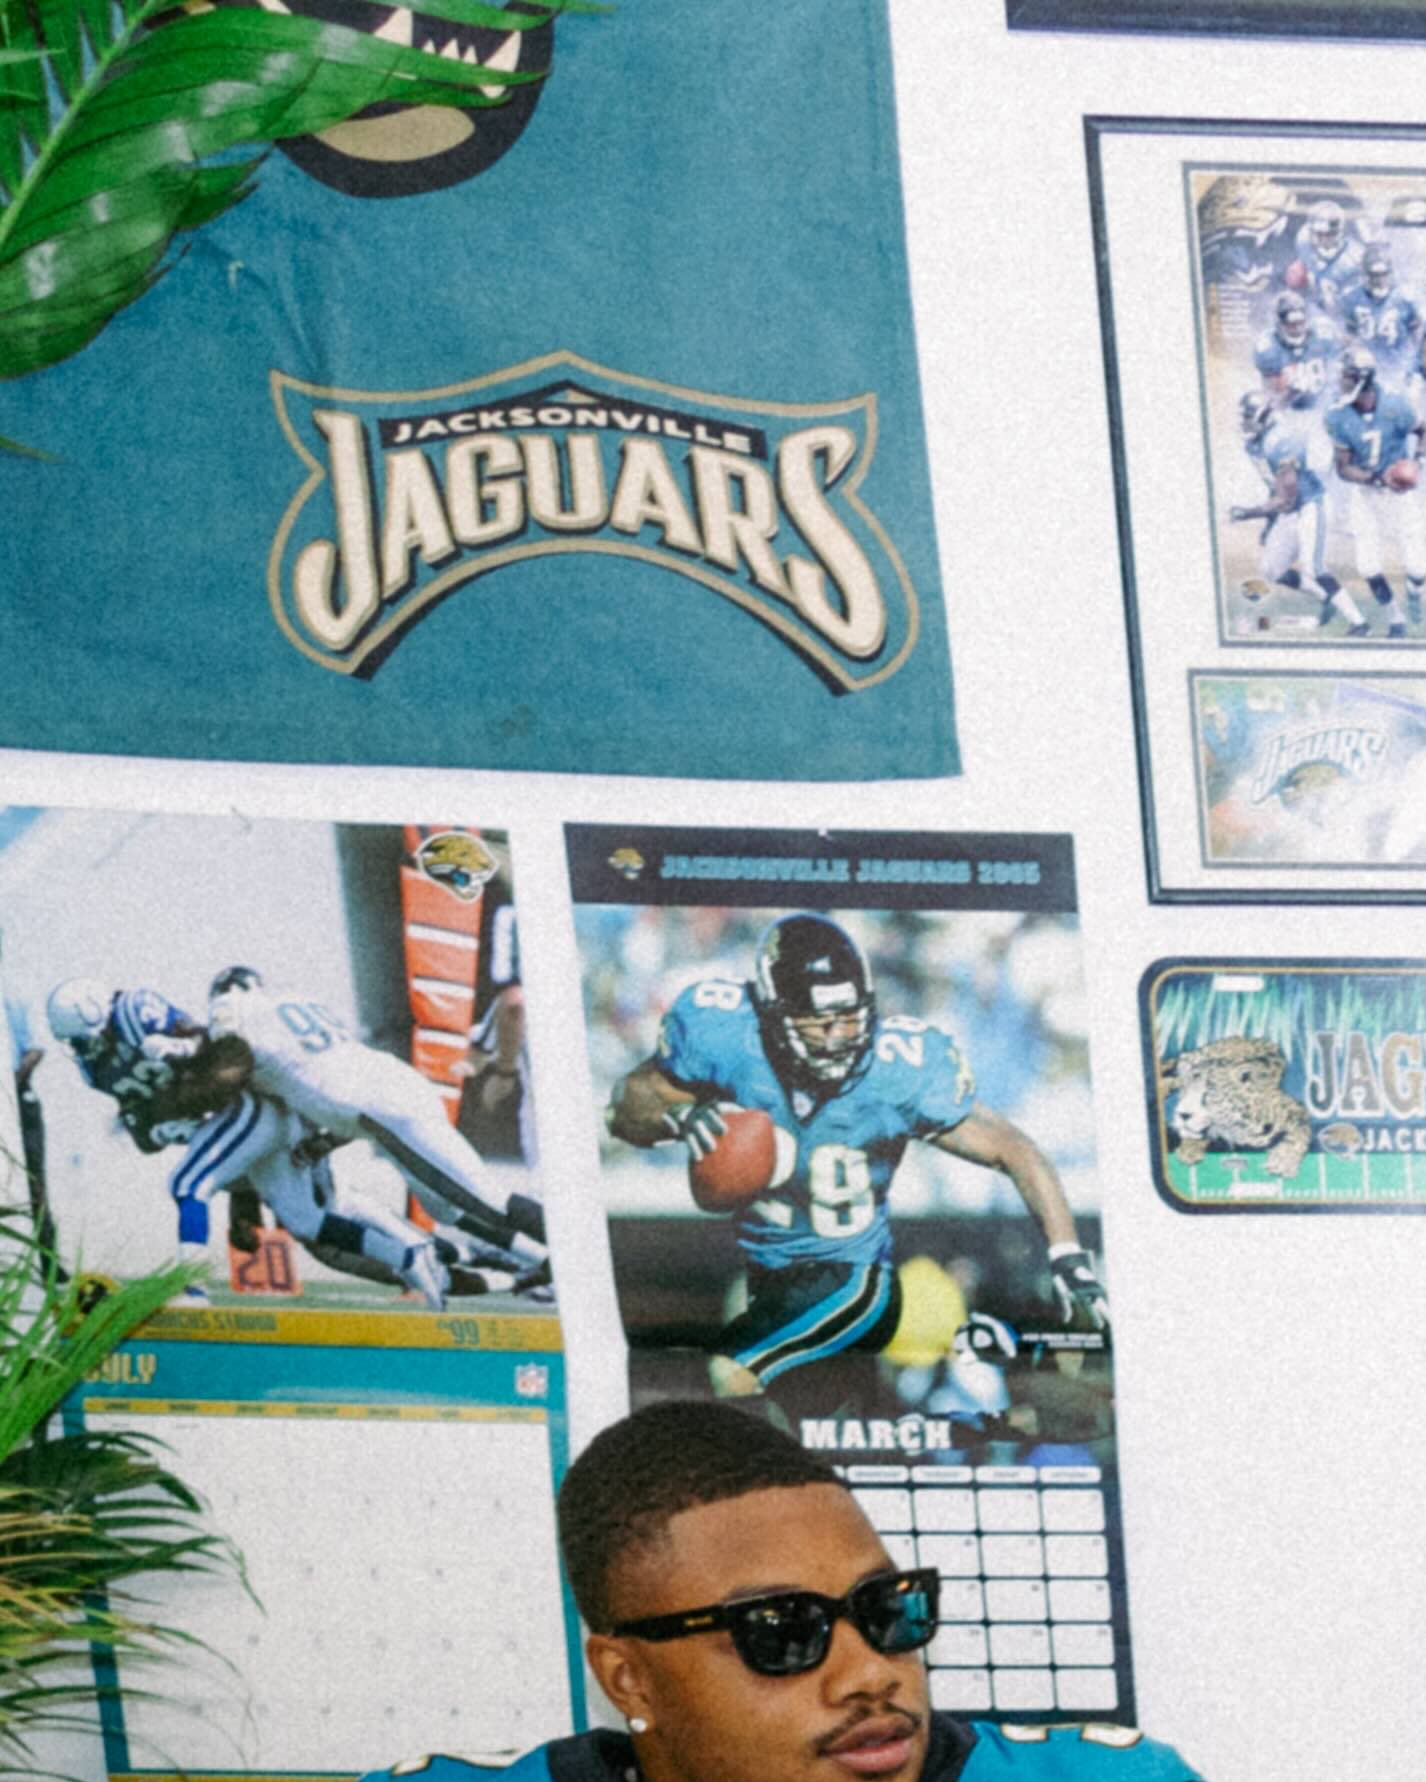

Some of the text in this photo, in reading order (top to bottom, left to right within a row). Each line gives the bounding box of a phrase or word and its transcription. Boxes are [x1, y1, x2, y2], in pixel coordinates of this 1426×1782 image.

[391, 401, 755, 453] JACKSONVILLE
[1362, 431, 1382, 466] 7
[292, 409, 887, 659] JAGUARS
[800, 1417, 951, 1450] MARCH
